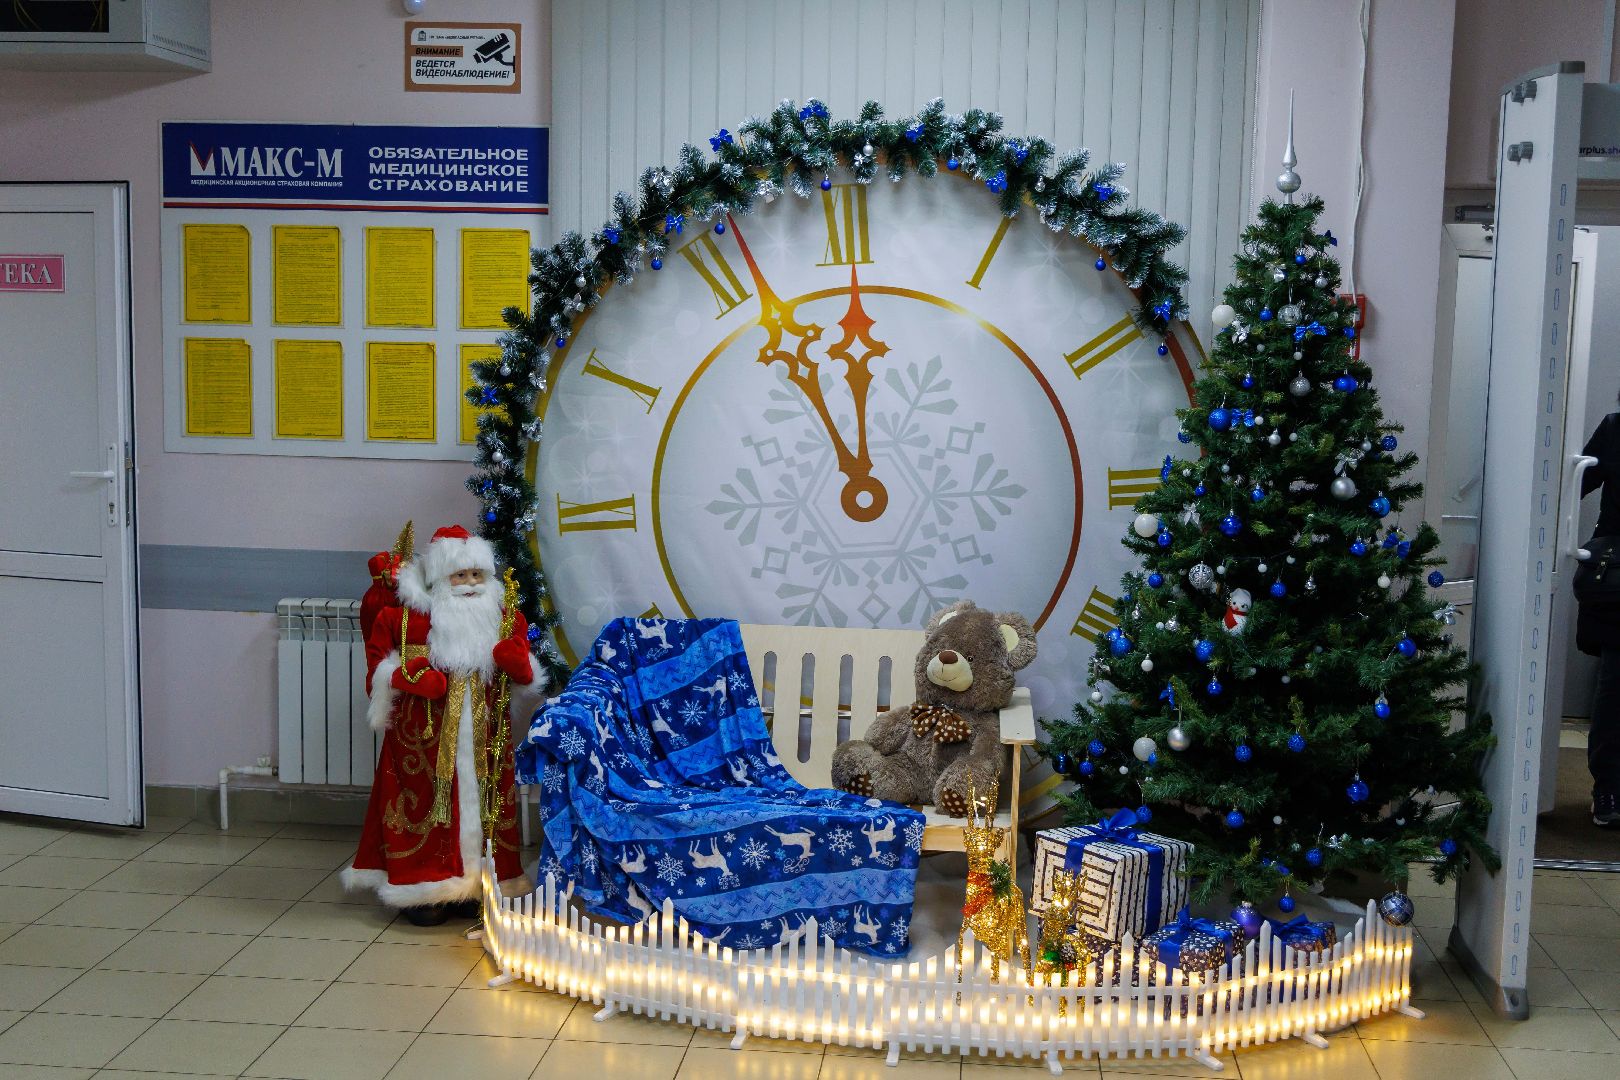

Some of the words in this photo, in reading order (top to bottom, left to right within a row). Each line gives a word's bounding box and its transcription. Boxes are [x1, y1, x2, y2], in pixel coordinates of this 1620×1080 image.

[415, 47, 461, 56] ВНИМАНИЕ
[415, 60, 455, 68] ВЕДЕТСЯ
[415, 69, 510, 79] ВИДЕОНАБЛЮДЕНИЕ!
[368, 146, 529, 161] ОБЯЗАТЕЛЬНОЕ
[1579, 146, 1620, 155] rplus.sh
[220, 146, 344, 178] МАКС-М
[368, 162, 529, 178] МЕДИЦИНСКОЕ
[234, 179, 276, 187] АКЦИОНЕРНАЯ
[368, 178, 529, 193] СТРАХОВАНИЕ
[0, 262, 54, 285] ЕКА
